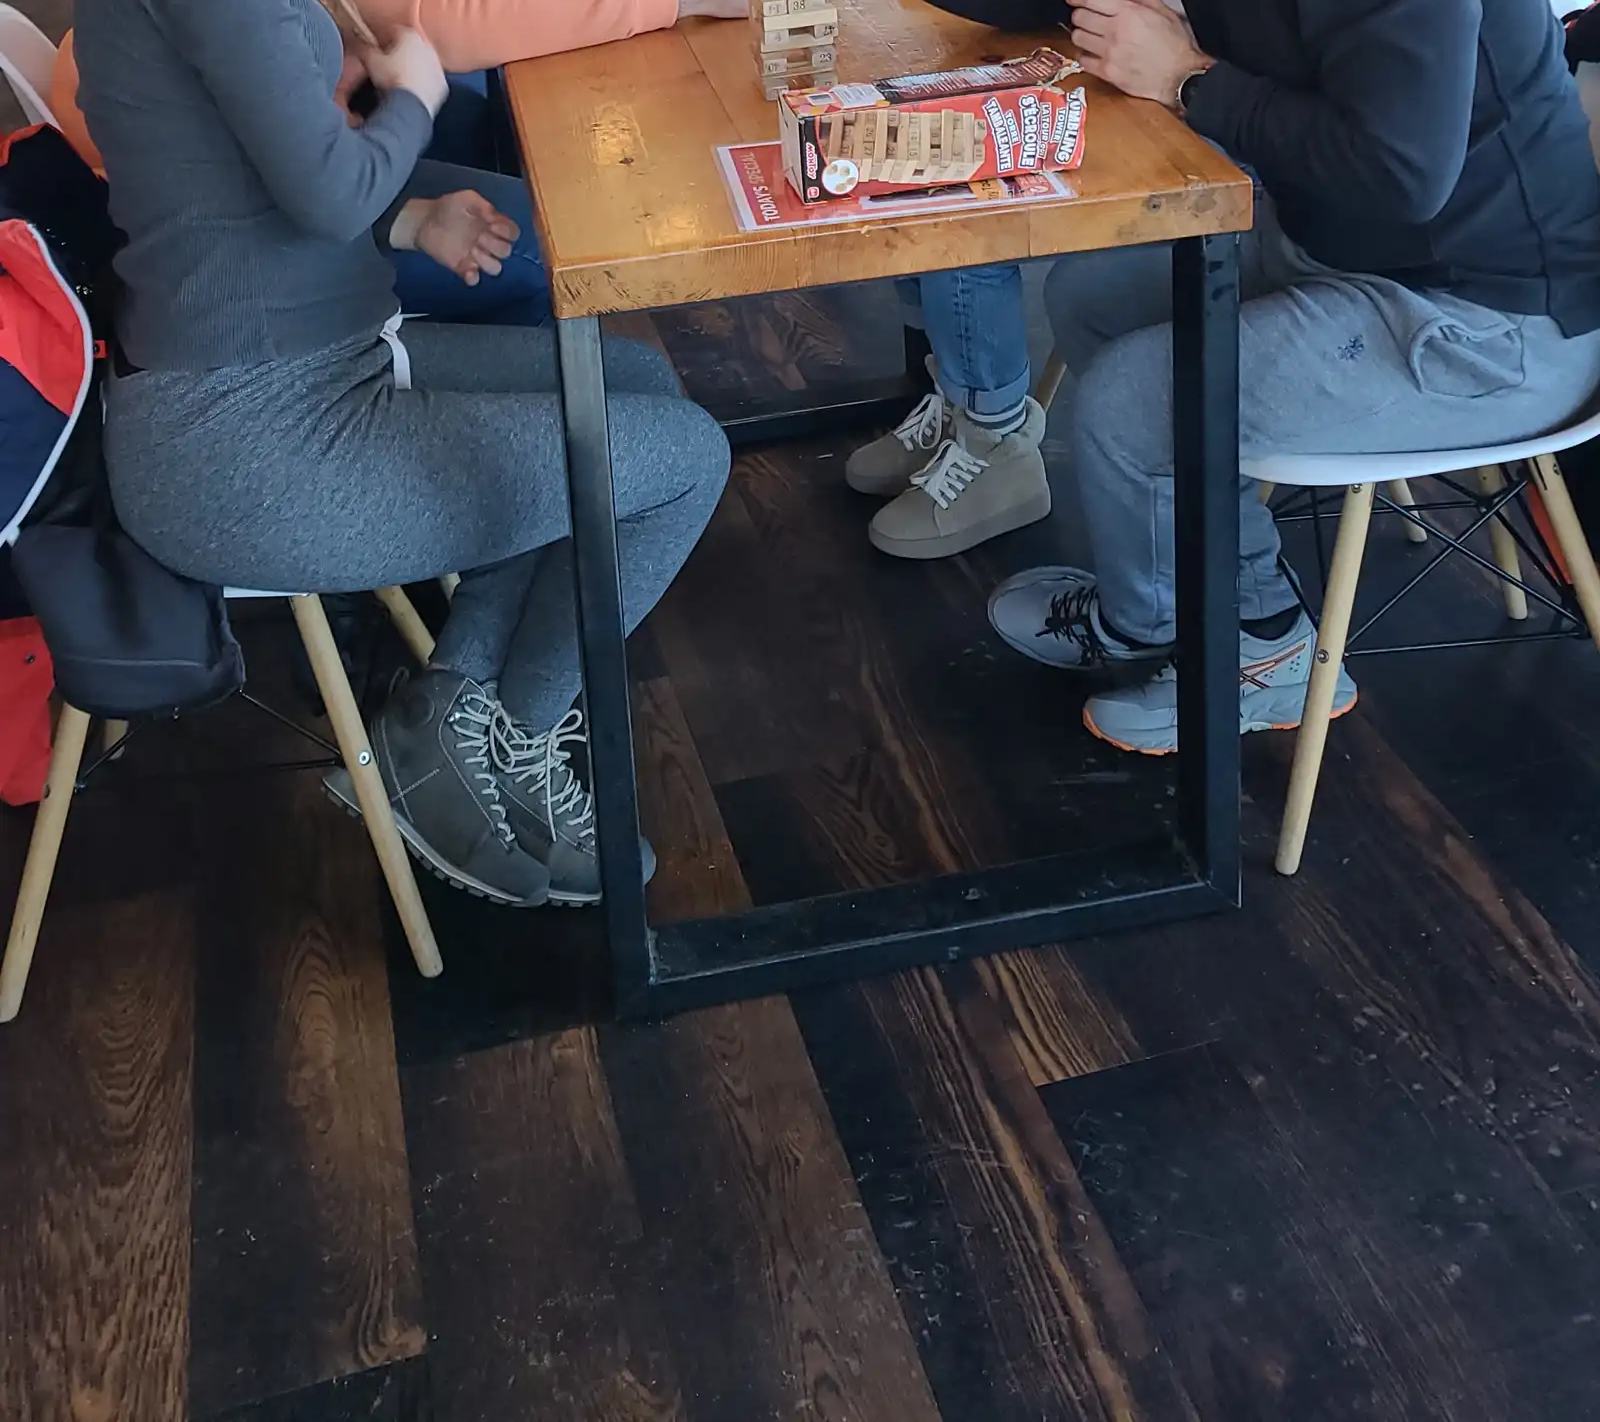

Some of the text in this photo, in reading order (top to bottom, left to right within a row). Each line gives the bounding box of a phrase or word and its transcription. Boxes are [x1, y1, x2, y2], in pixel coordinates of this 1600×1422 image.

[820, 53, 832, 63] 23
[986, 100, 1012, 171] TAMBALEANTE
[1005, 111, 1019, 143] TORRE
[806, 142, 818, 180] MONTOY
